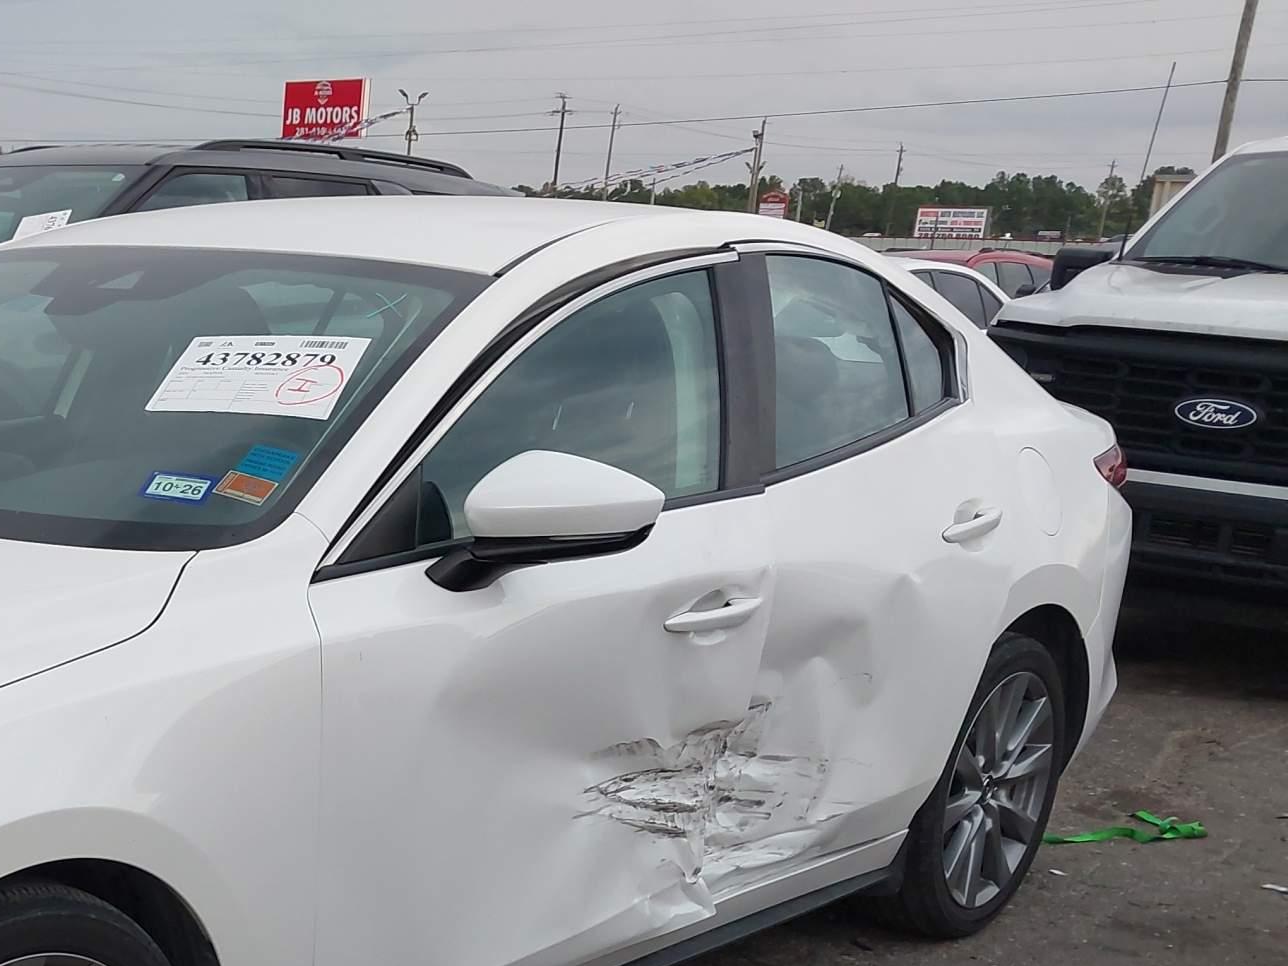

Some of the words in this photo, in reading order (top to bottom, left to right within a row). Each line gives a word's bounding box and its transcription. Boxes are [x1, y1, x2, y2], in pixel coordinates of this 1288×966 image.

[286, 108, 301, 125] JB
[304, 106, 359, 125] MOTORS
[196, 352, 337, 367] 43782879
[1189, 402, 1243, 425] Ford
